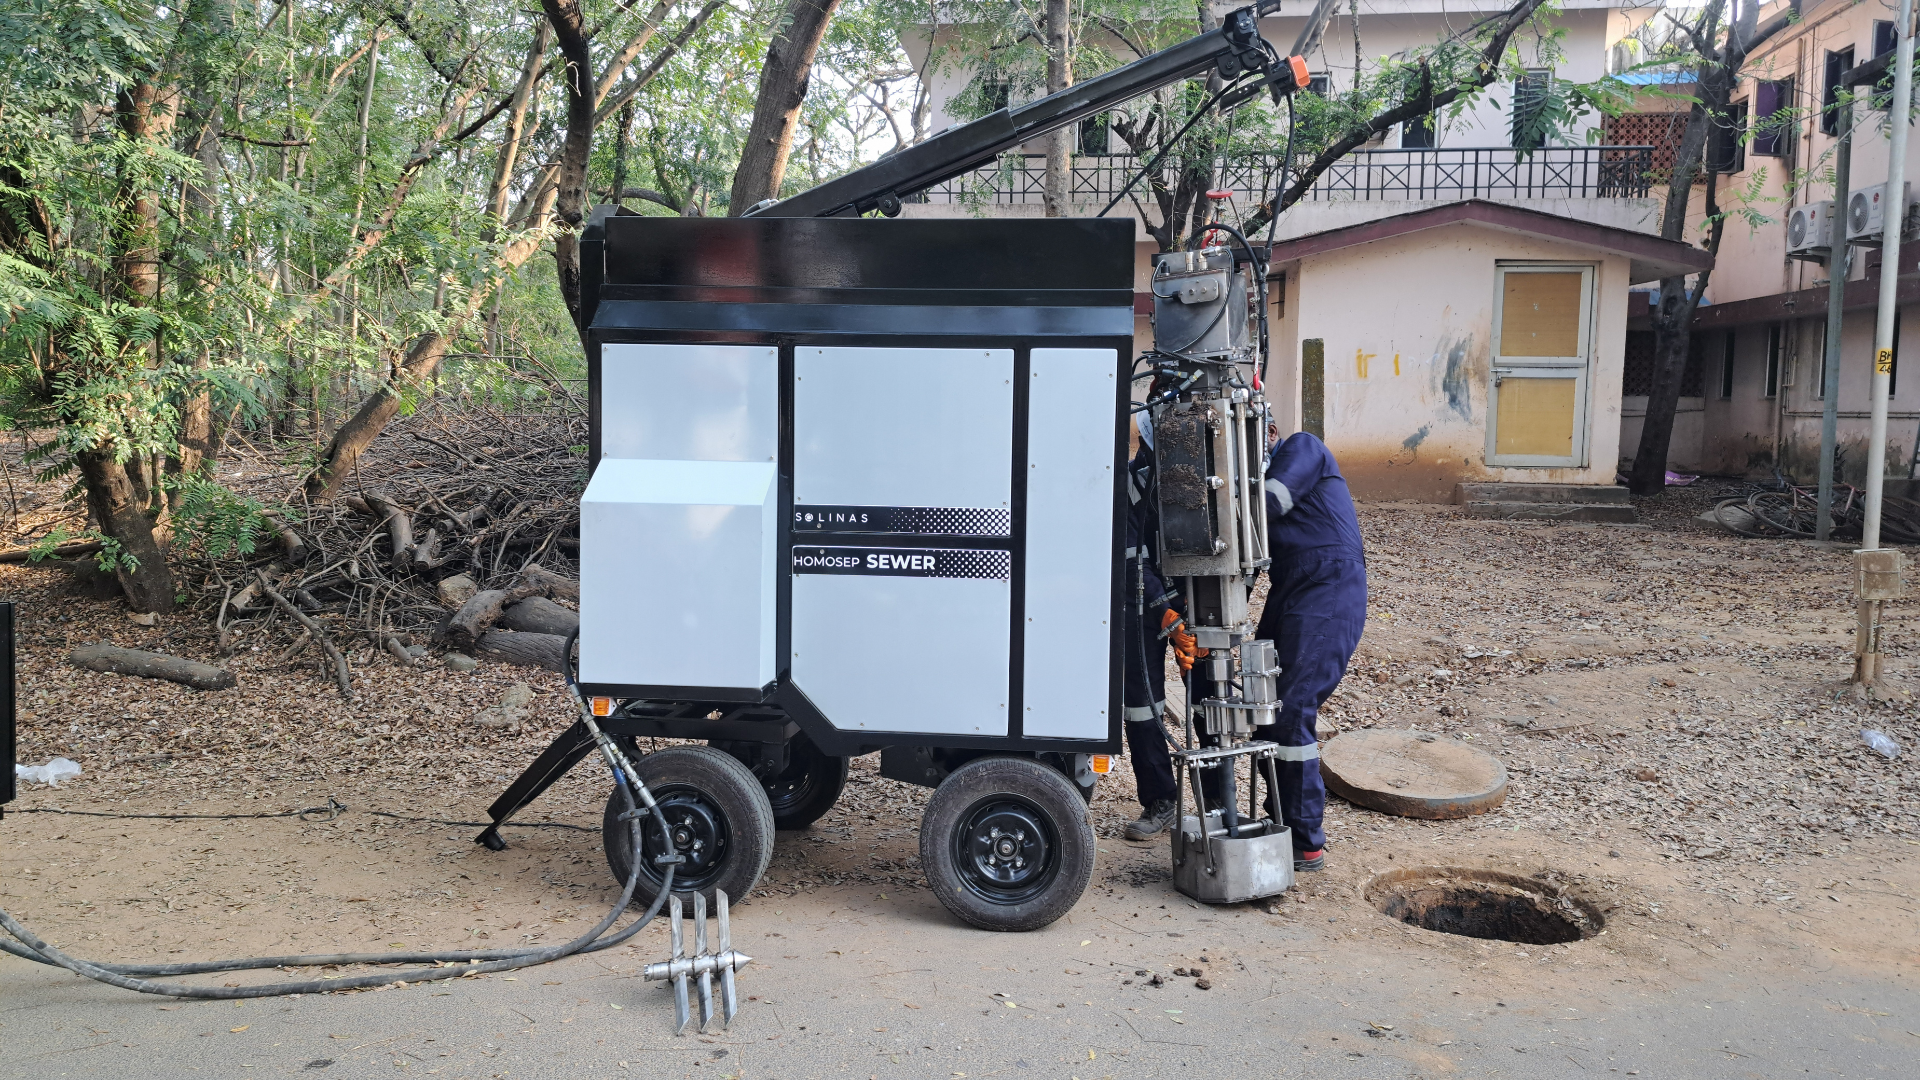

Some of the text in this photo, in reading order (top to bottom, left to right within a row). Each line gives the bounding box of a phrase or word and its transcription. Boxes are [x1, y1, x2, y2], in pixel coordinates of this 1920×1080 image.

[795, 512, 869, 523] SOLINAS
[793, 554, 936, 570] HOMOSEP SEWER
